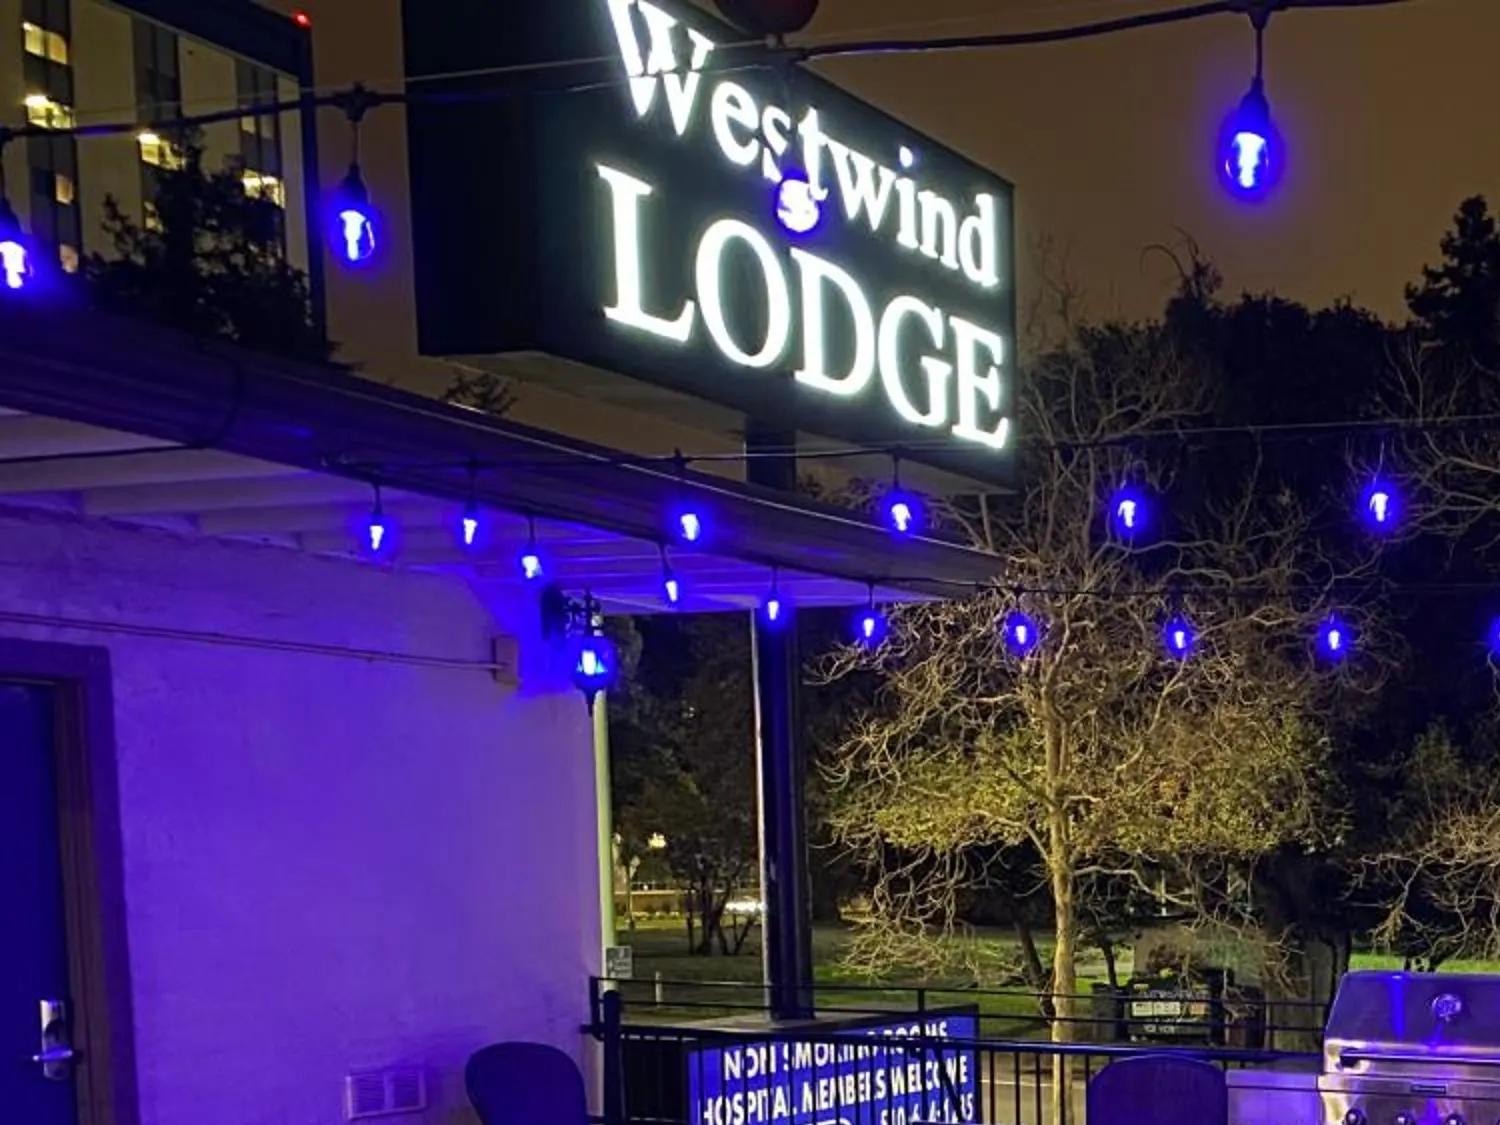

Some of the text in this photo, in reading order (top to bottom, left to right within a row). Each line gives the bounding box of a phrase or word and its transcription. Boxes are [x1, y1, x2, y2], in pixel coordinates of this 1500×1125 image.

[606, 0, 999, 288] Westwind
[597, 163, 1010, 450] LODGE
[724, 1045, 777, 1081] NON
